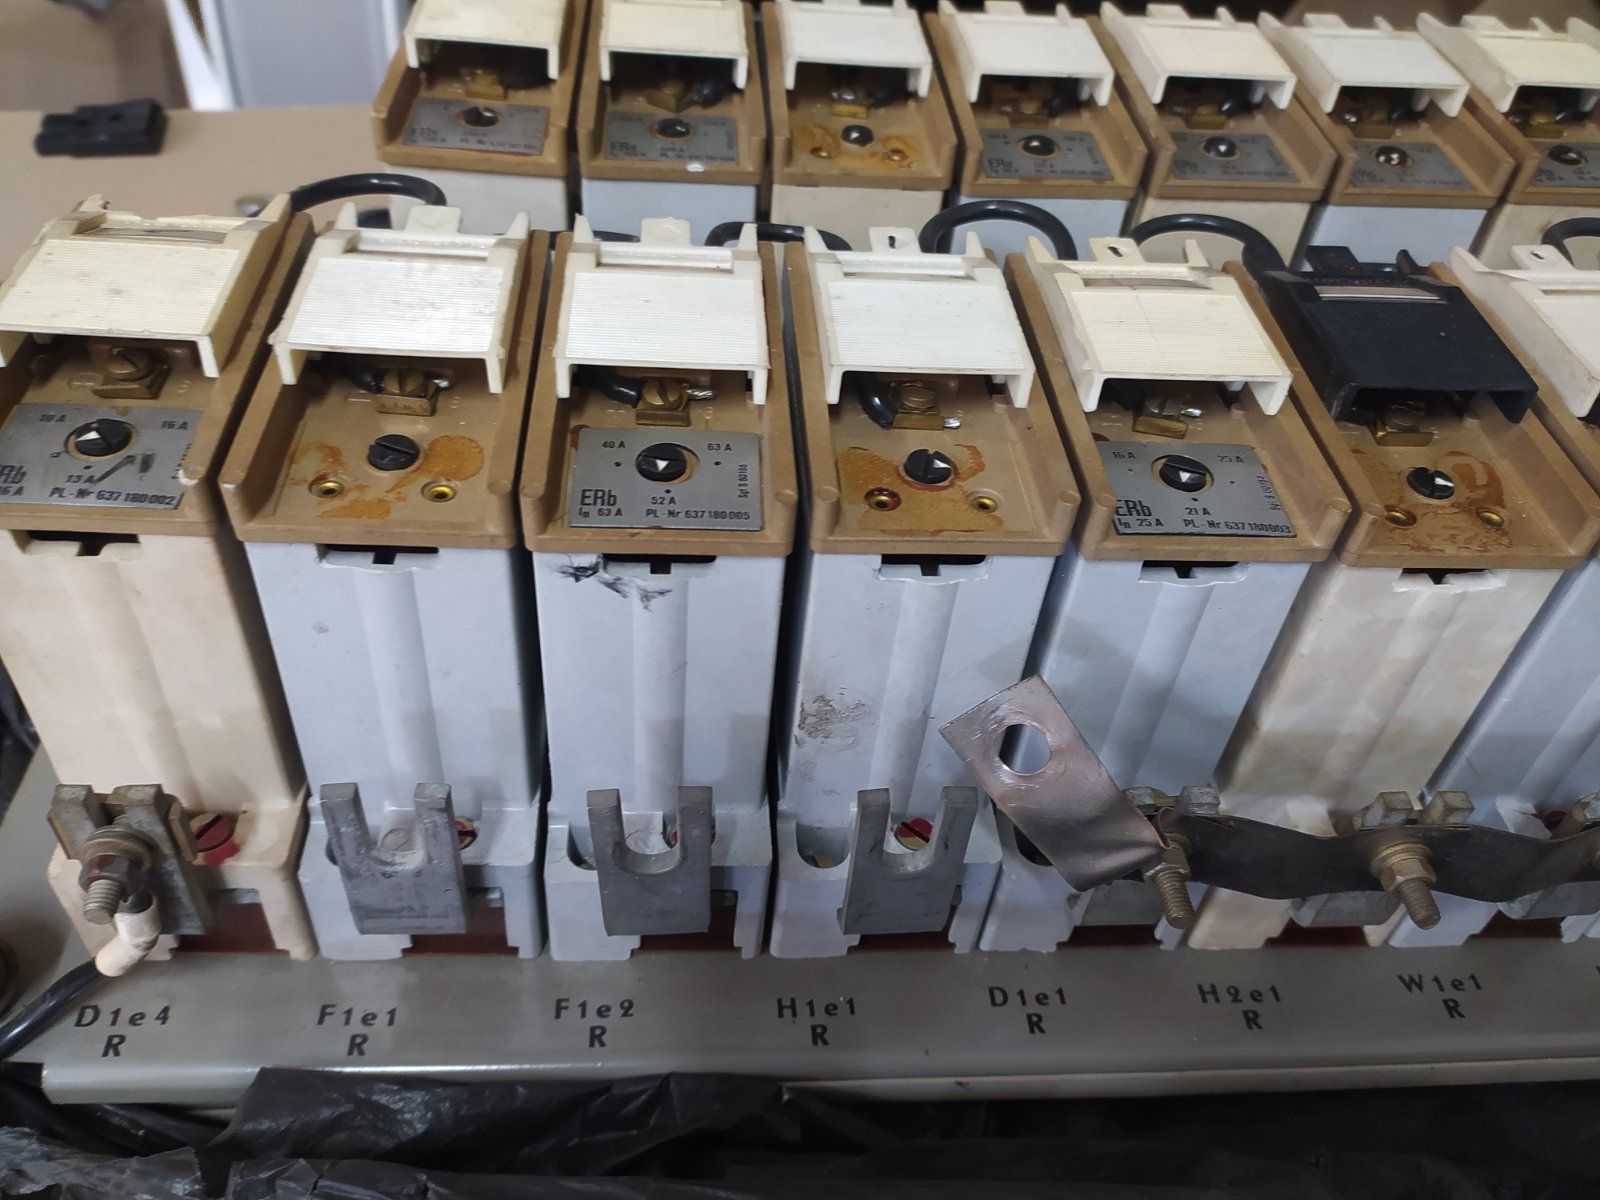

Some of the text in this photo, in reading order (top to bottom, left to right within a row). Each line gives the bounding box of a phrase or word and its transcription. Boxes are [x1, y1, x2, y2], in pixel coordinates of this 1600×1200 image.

[55, 414, 67, 422] A
[178, 421, 189, 430] A
[602, 441, 626, 449] 40 A
[708, 443, 721, 451] 63
[1218, 455, 1233, 463] 25
[0, 464, 27, 484] Rb
[66, 474, 96, 484] 13 A
[12, 486, 24, 496] A
[580, 489, 617, 507] ERb
[651, 497, 677, 505] 52 A
[598, 508, 612, 517] 63
[614, 508, 623, 517] A
[1185, 507, 1212, 516] 21 A
[1136, 518, 1152, 527] 25
[1156, 519, 1164, 527] A
[1197, 983, 1281, 1003] H2e1
[1396, 974, 1483, 993] W1e1
[988, 985, 1067, 1007] D1e1
[73, 1004, 171, 1027] D1e4
[317, 1004, 398, 1026] F1e1
[555, 998, 635, 1019] F1e2
[776, 997, 856, 1018] H1e1
[1442, 998, 1466, 1018] R
[1026, 1013, 1046, 1034] R
[1241, 1009, 1264, 1030] R
[347, 1034, 369, 1056] R
[588, 1025, 608, 1048] R
[810, 1024, 829, 1046] R
[101, 1034, 126, 1057] R
